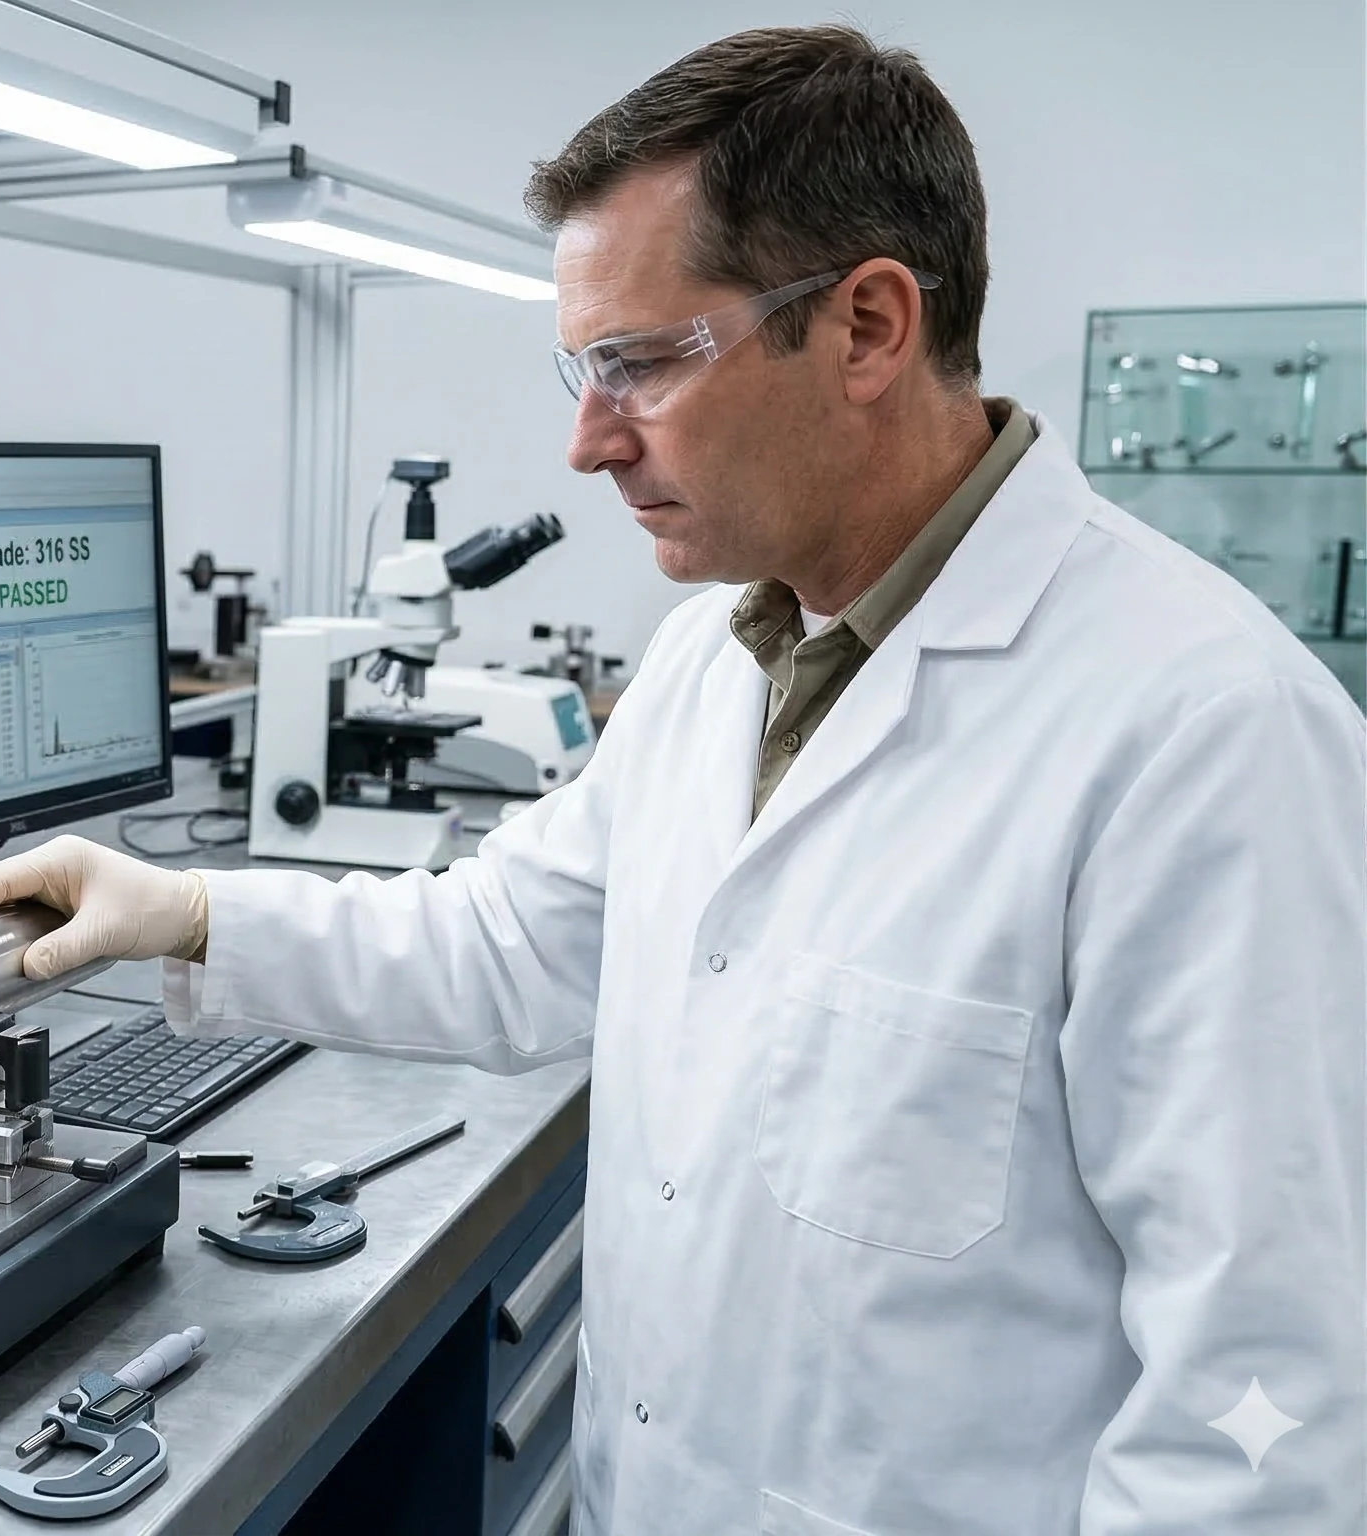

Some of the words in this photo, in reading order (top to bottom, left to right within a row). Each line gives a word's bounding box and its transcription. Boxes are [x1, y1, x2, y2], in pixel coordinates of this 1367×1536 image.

[36, 538, 63, 564] 316
[70, 536, 90, 561] SS
[0, 580, 68, 608] PASSED
